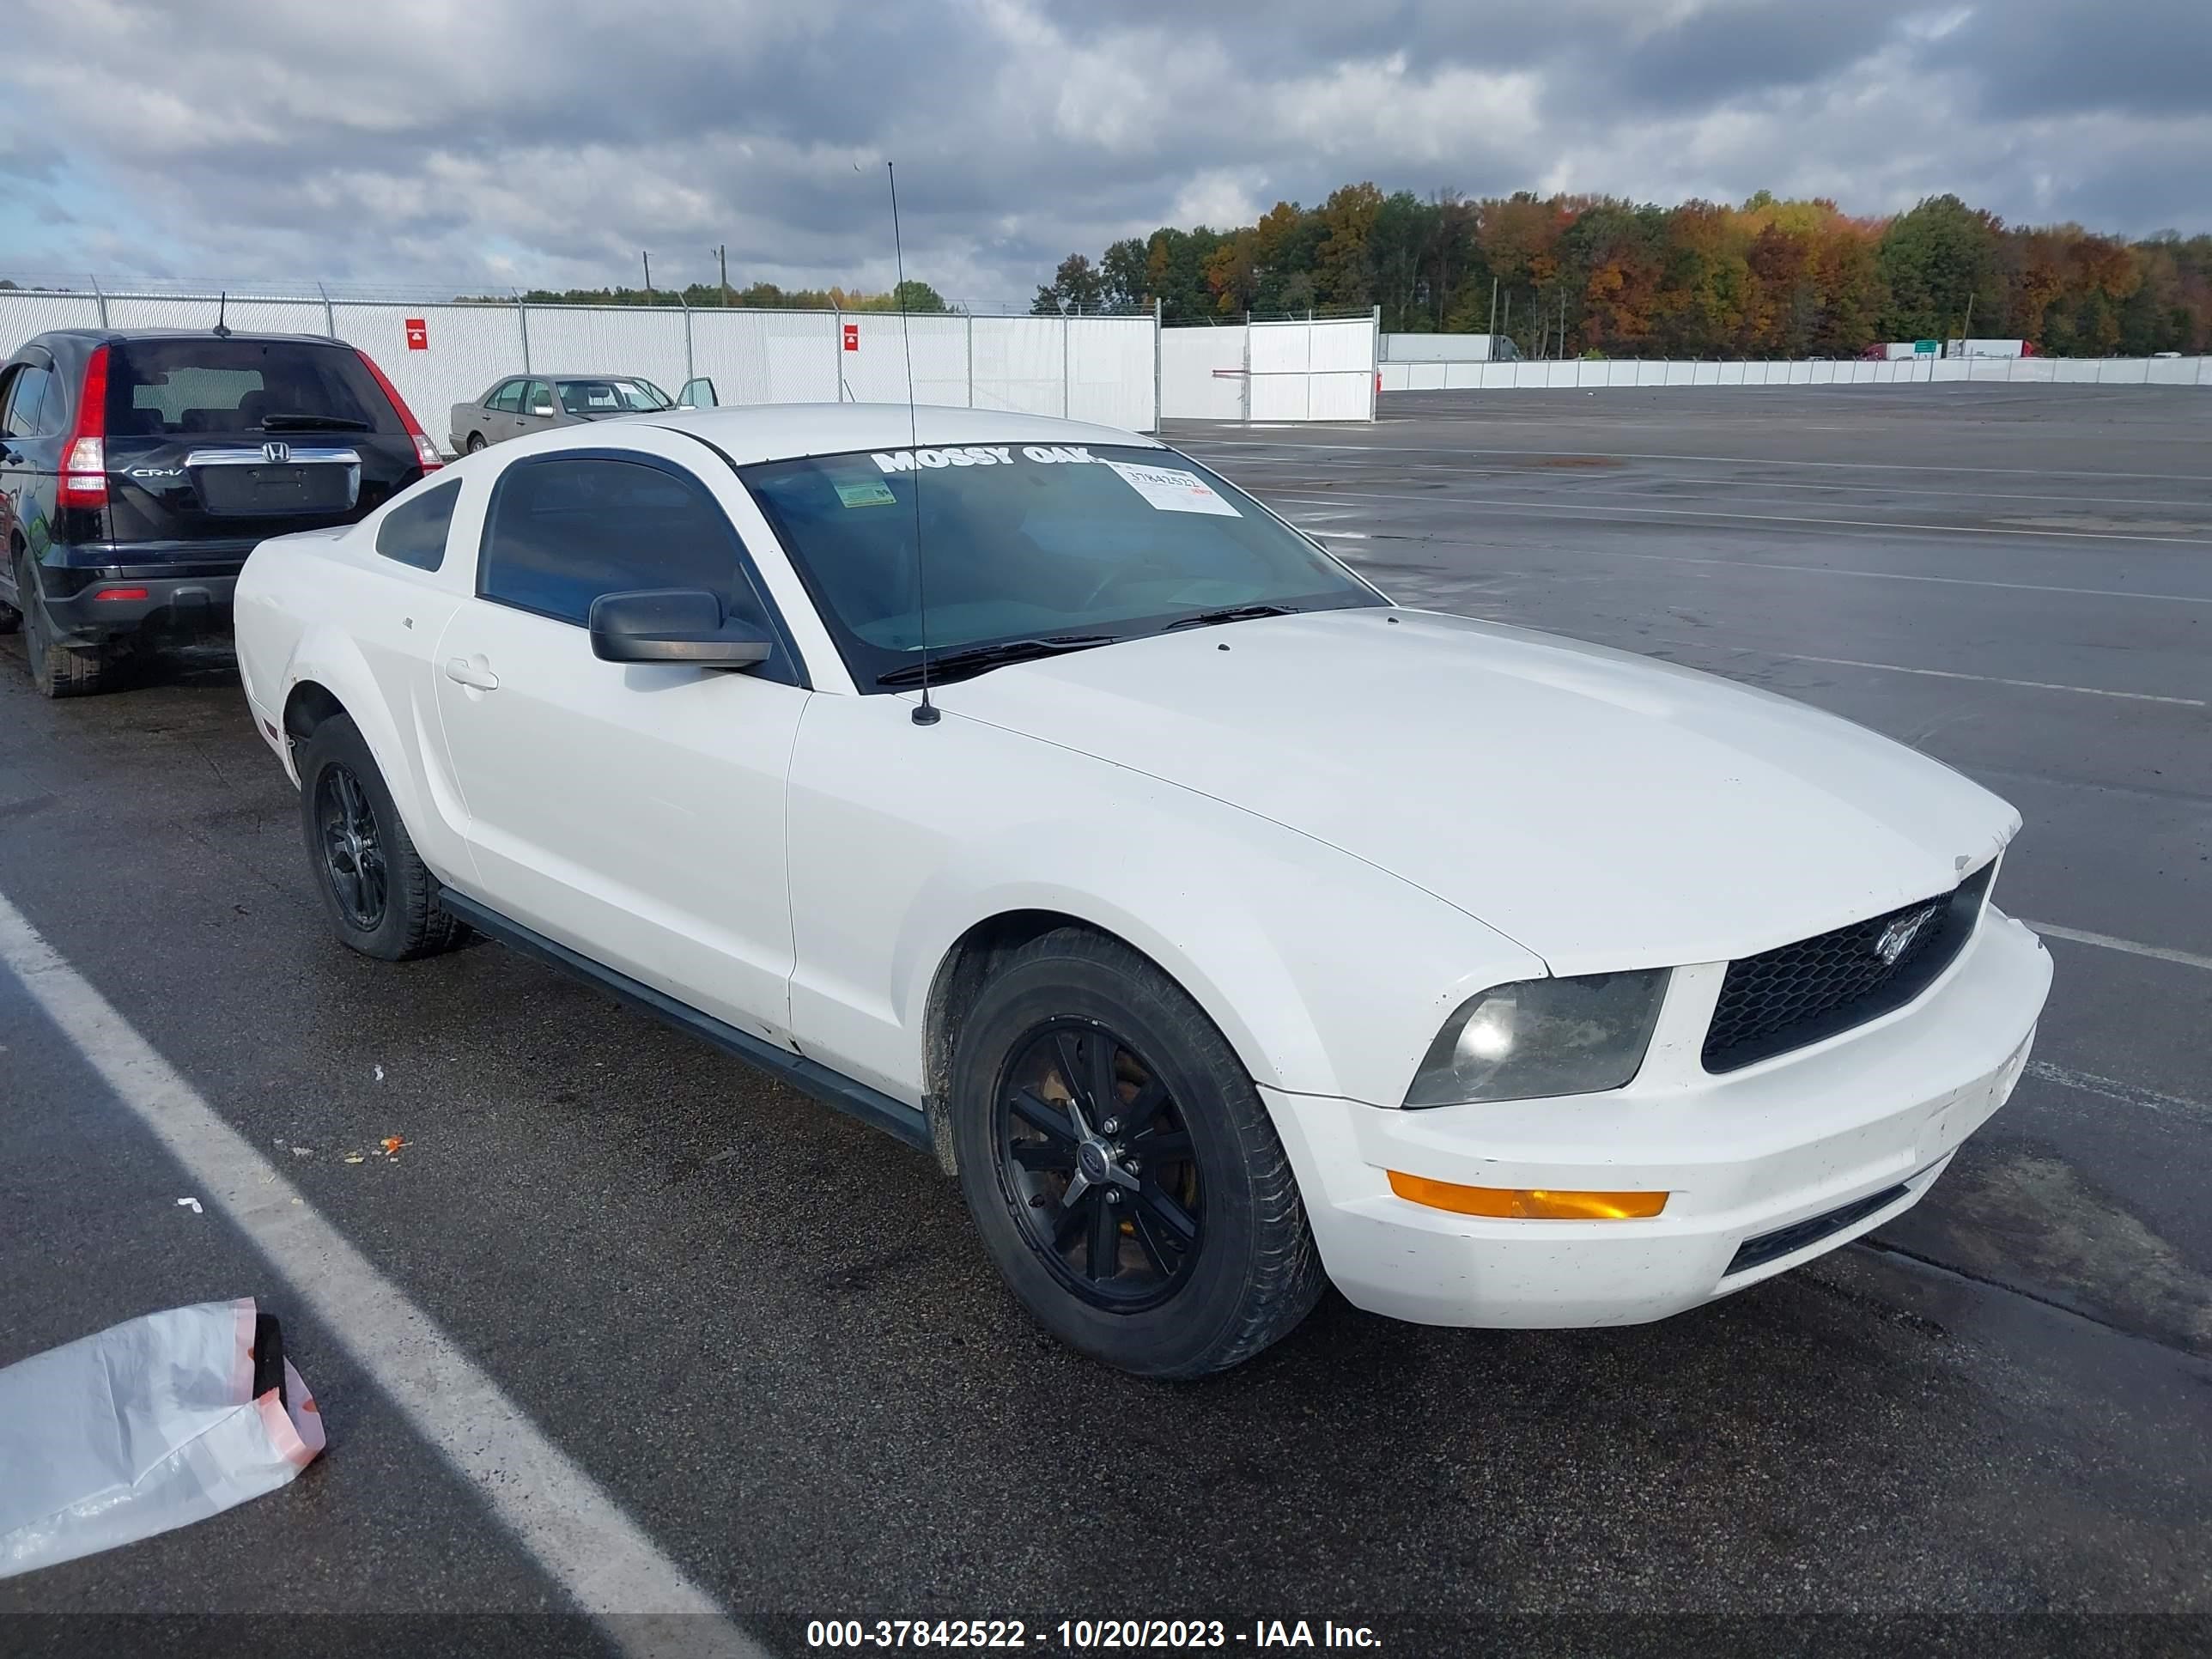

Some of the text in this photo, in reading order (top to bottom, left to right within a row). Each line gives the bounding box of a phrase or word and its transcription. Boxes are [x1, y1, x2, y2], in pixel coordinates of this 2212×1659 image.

[871, 447, 1094, 473] MOSSY OAK
[131, 469, 184, 477] CR-V
[1127, 471, 1200, 488] 37842522
